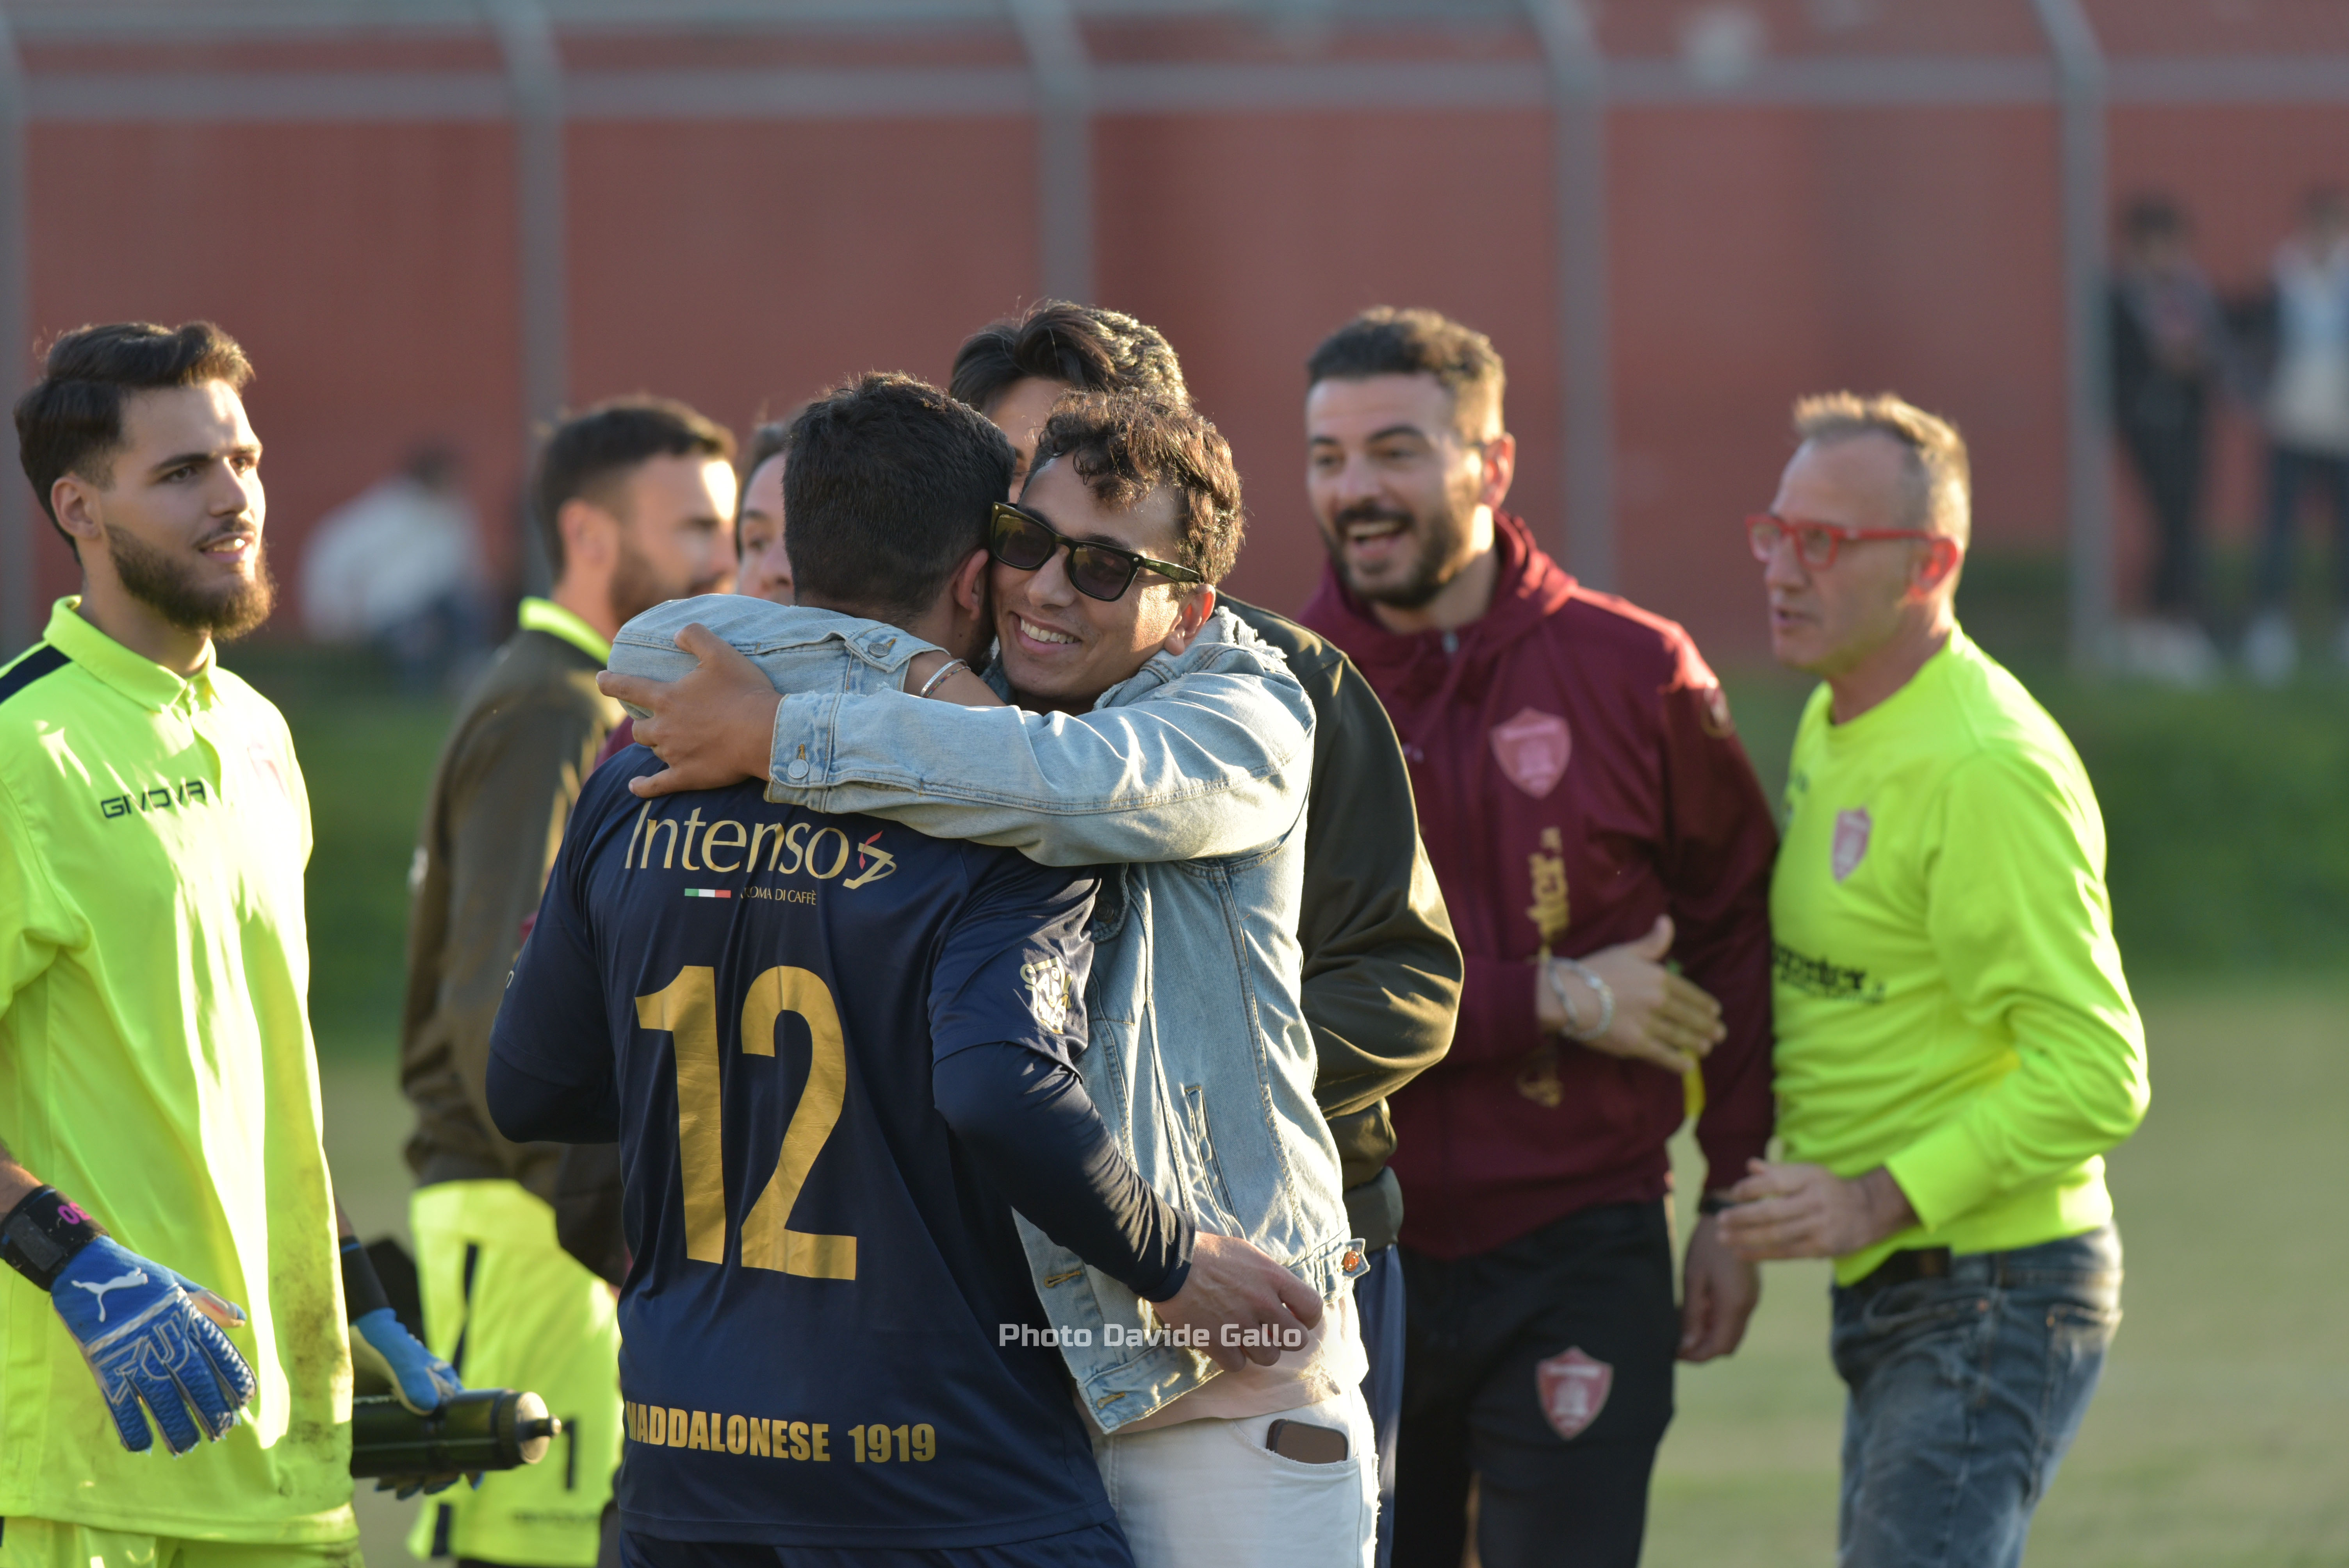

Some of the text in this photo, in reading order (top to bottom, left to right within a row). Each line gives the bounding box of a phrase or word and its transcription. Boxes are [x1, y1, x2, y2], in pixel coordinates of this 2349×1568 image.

[101, 780, 206, 818] GIVOVA
[625, 800, 849, 879] Intenso
[775, 889, 786, 901] DI
[788, 889, 816, 905] CAFFÈ
[635, 965, 857, 1281] 12
[626, 1401, 936, 1463] MADDALONESE 1919
